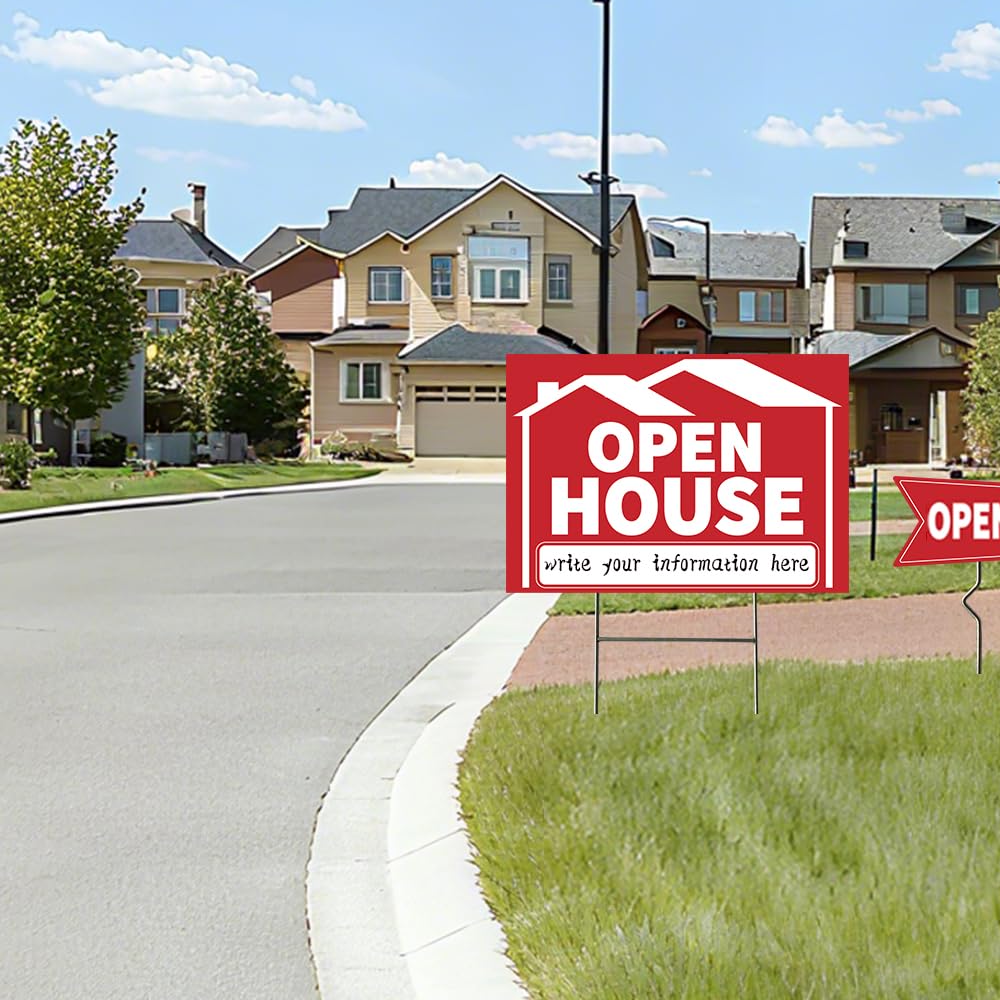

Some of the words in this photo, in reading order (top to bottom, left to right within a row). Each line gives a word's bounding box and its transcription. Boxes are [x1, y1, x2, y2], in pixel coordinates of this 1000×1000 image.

[587, 421, 762, 473] OPEN
[551, 476, 804, 536] HOUSE
[544, 554, 592, 572] write
[601, 556, 641, 577] your
[652, 553, 759, 572] information
[770, 554, 810, 572] here
